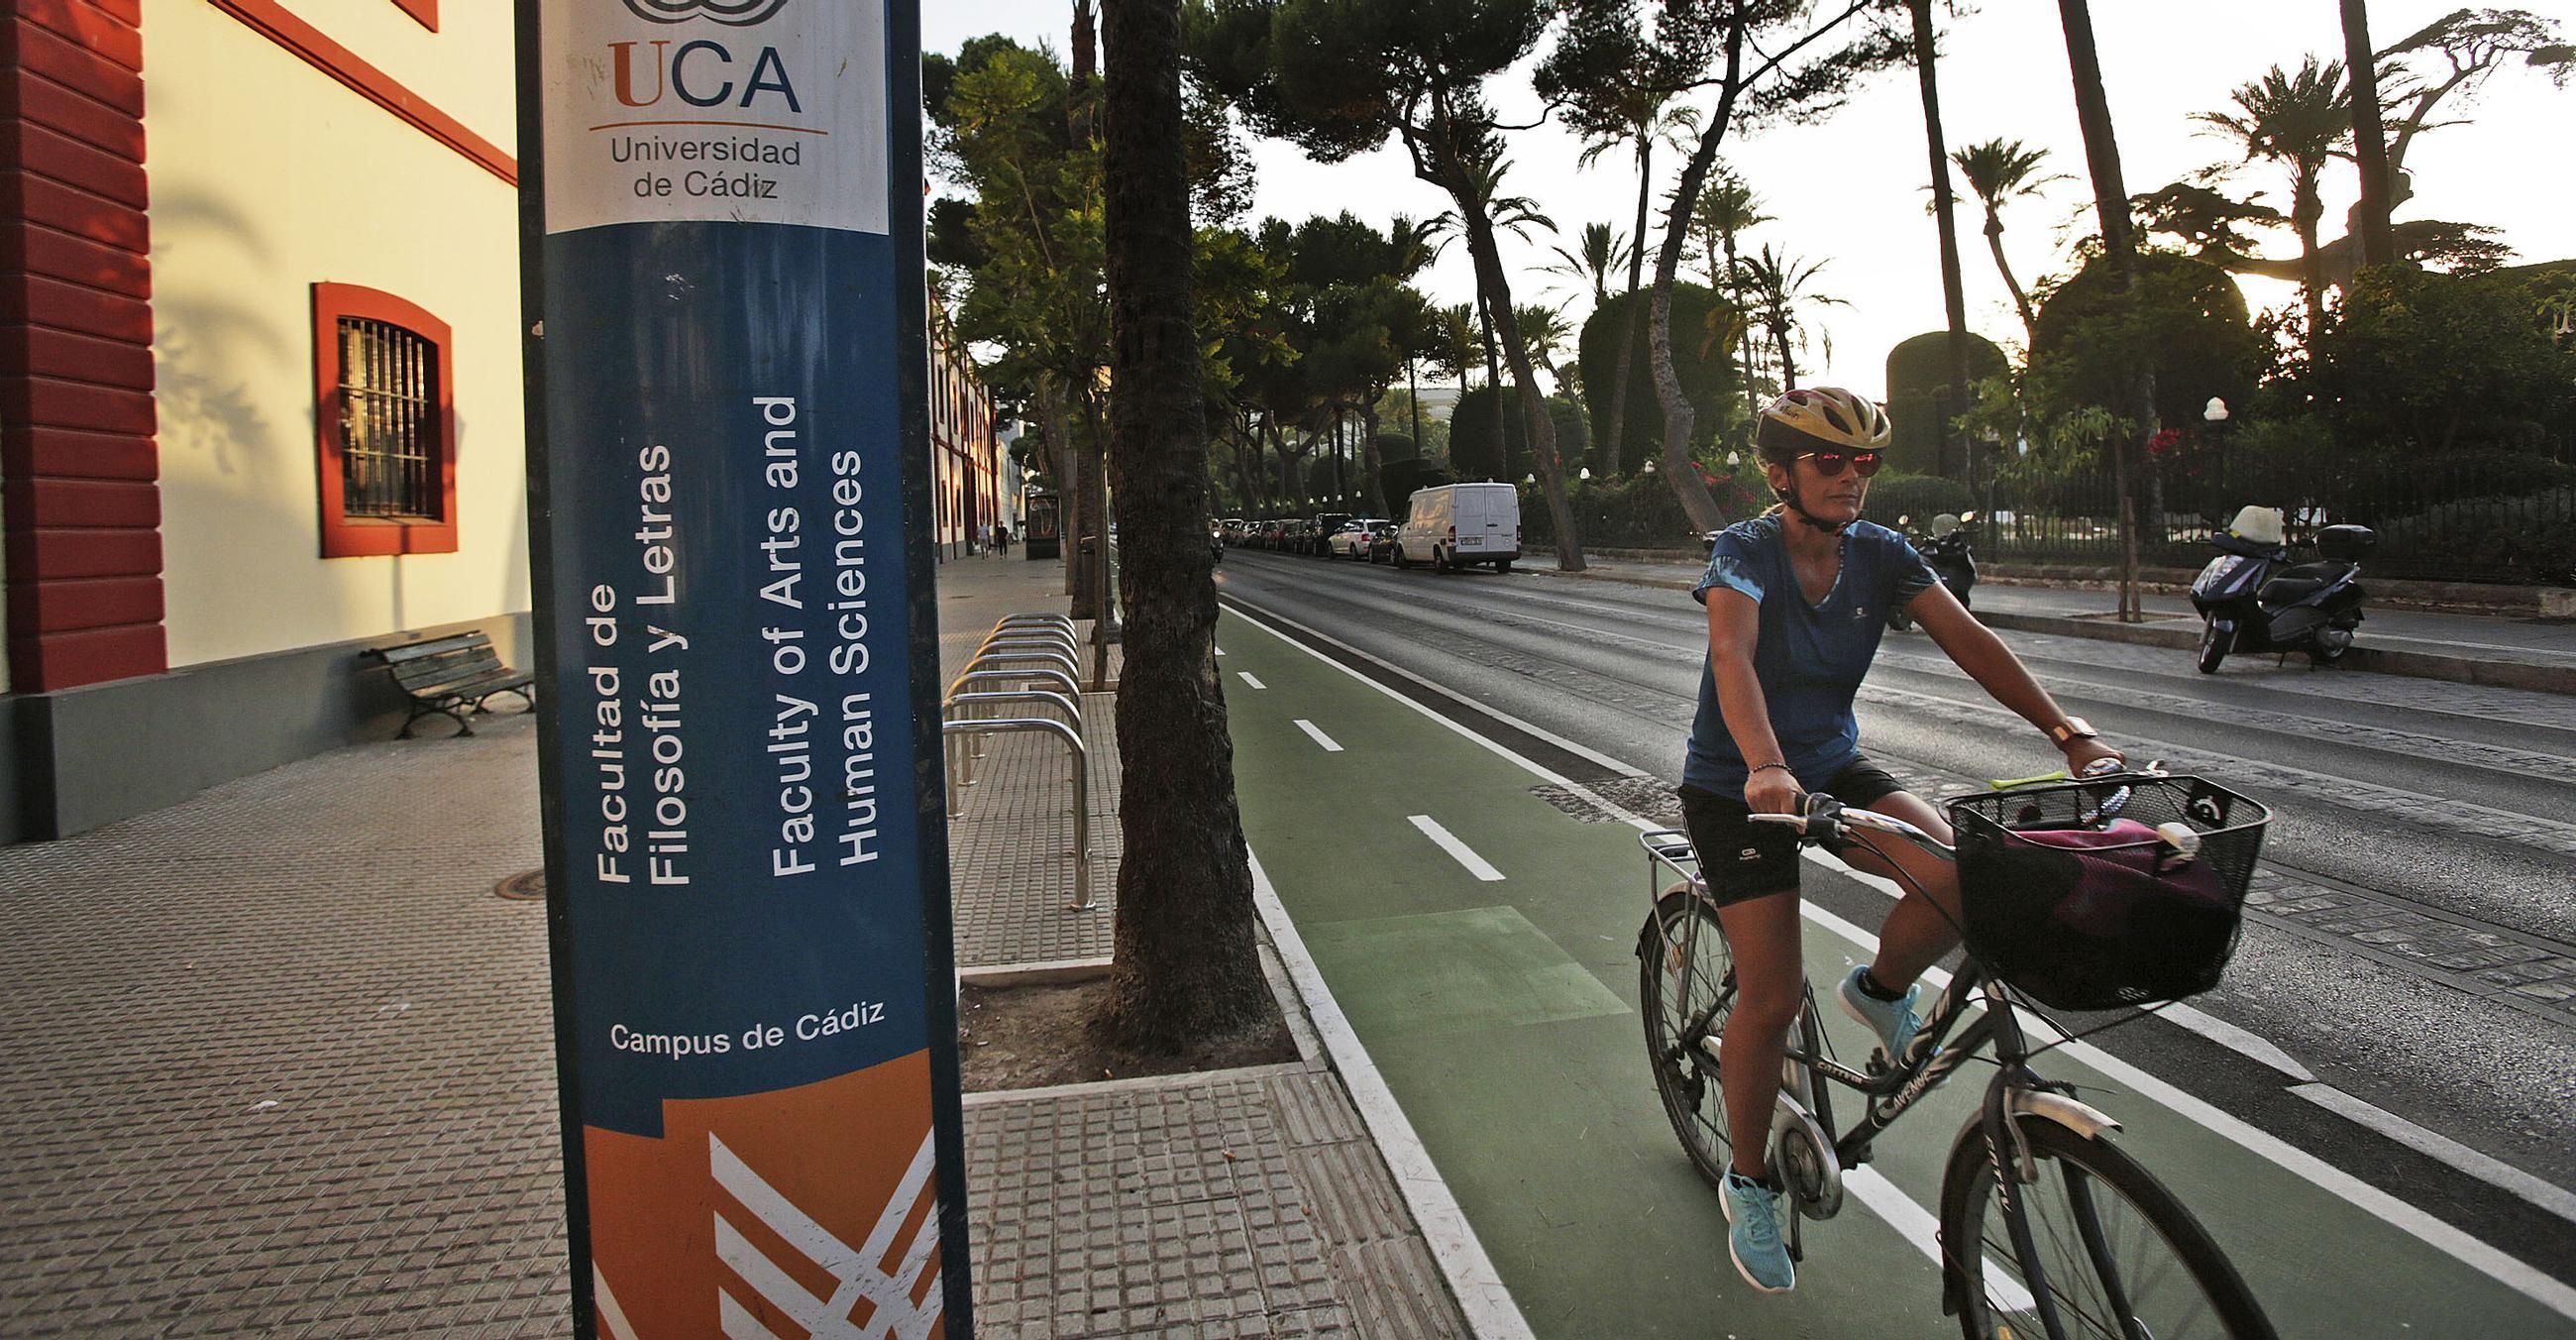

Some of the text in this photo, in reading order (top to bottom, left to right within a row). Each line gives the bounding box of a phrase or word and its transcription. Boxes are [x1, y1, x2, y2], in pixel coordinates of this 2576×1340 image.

[607, 40, 803, 114] UCA
[611, 135, 802, 167] Universidad
[633, 169, 779, 199] de Cádiz
[634, 444, 691, 886] Filosofía y Letras
[752, 395, 819, 877] Faculty of Arts and
[827, 448, 879, 867] Human Sciences
[586, 583, 631, 884] Facultad de
[609, 1000, 886, 1061] Campus de Cádiz
[1892, 1069, 1932, 1111] AVENUE
